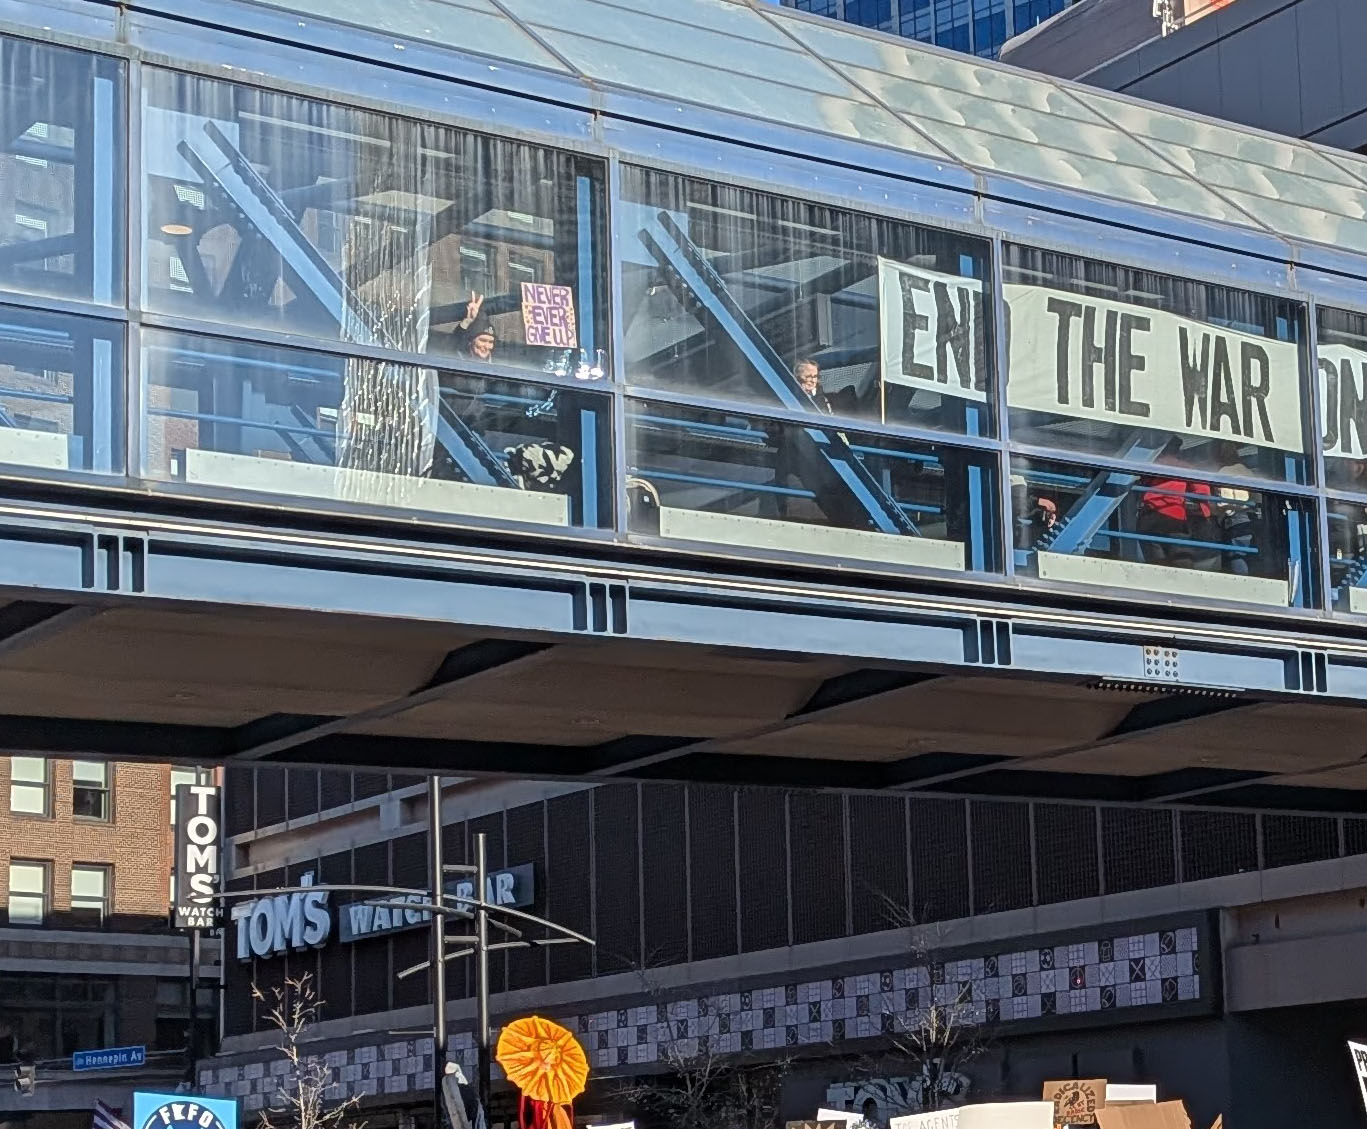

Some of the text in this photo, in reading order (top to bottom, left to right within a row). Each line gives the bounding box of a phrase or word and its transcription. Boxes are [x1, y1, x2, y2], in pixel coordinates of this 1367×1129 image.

[524, 284, 570, 307] NEVER
[531, 306, 569, 327] EVER
[527, 325, 575, 346] GIVE UP
[1047, 297, 1151, 418] THE
[1178, 326, 1275, 443] WAR
[178, 907, 224, 917] WATCH
[187, 917, 213, 927] BAR
[231, 871, 331, 960] TOM'S
[86, 1050, 143, 1065] Hennepin Av
